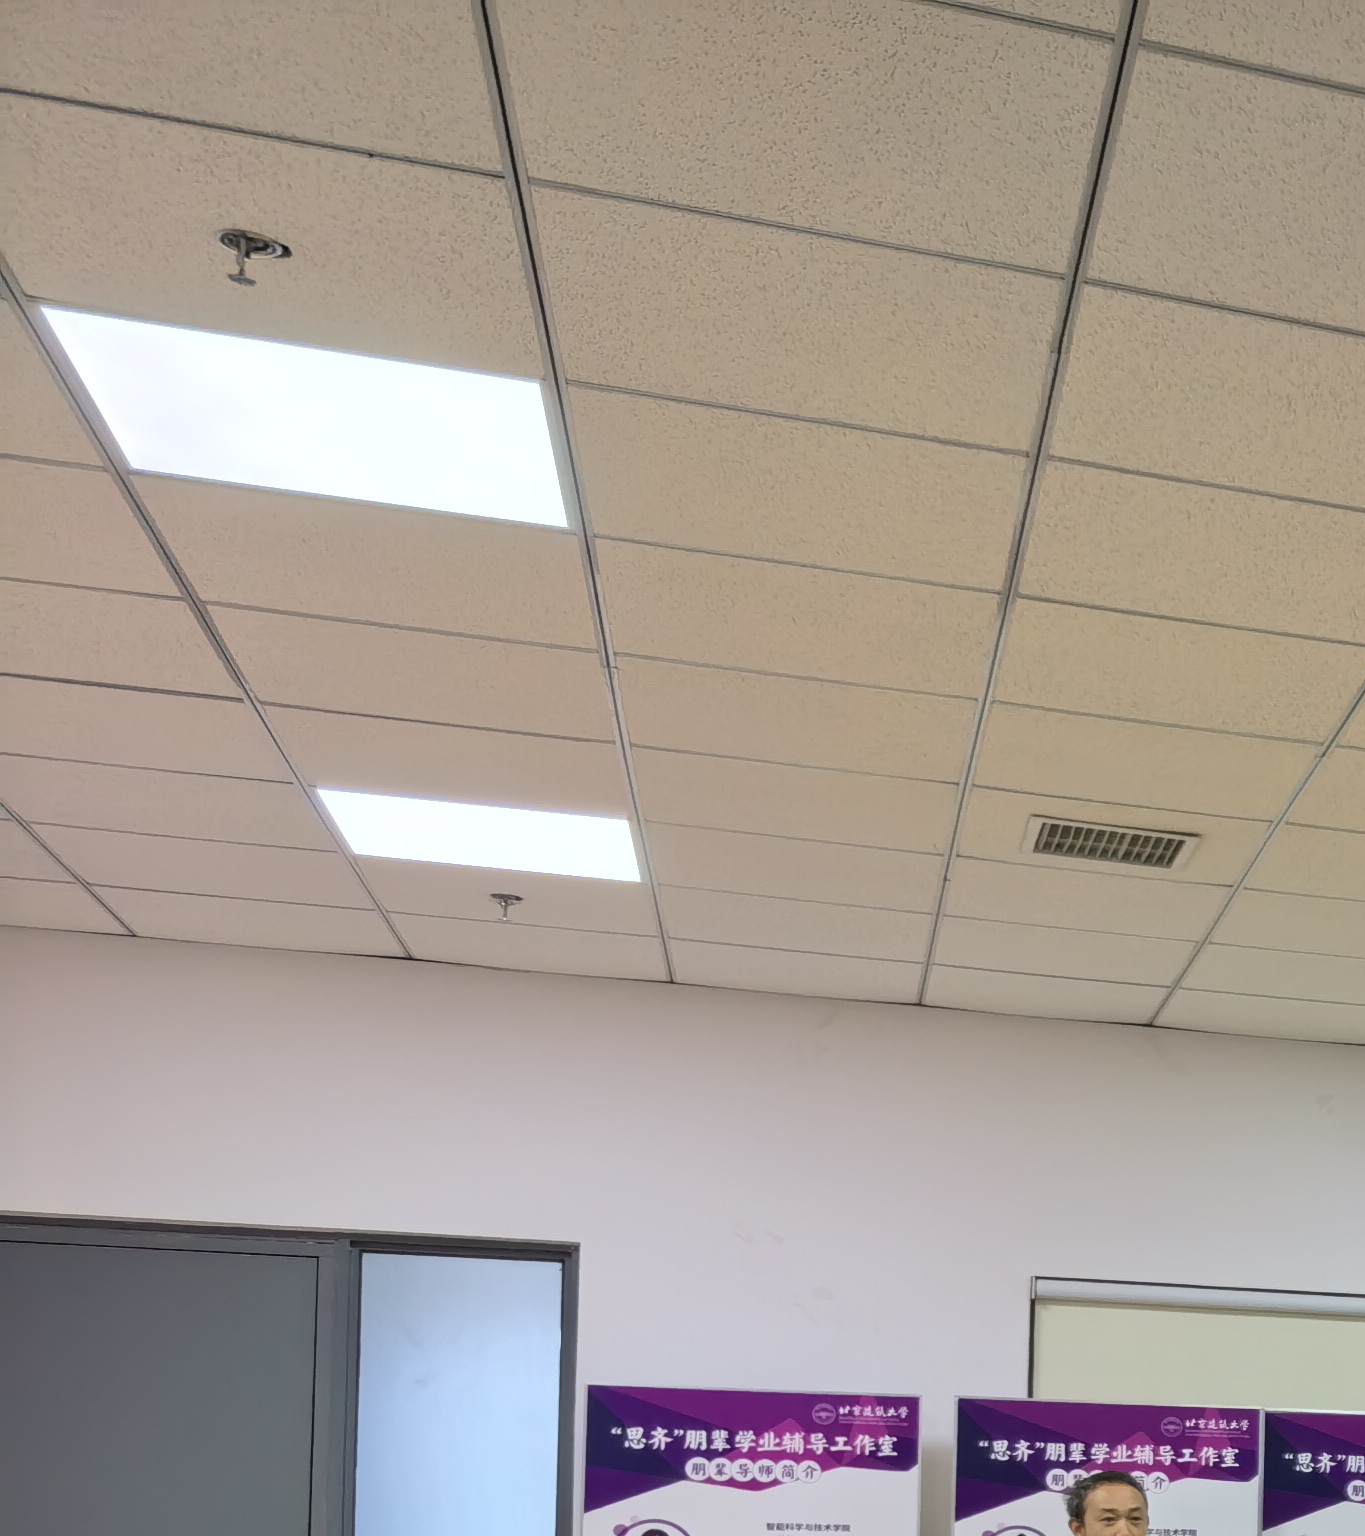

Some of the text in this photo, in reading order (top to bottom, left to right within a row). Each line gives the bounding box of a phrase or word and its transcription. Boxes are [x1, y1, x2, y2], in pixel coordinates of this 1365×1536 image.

[610, 1426, 898, 1457] “思齐”朋辈学业辅导工作室
[978, 1440, 1240, 1467] “思齐”朋辈学业辅导工作室
[689, 1461, 819, 1480] 朋辈导师简介
